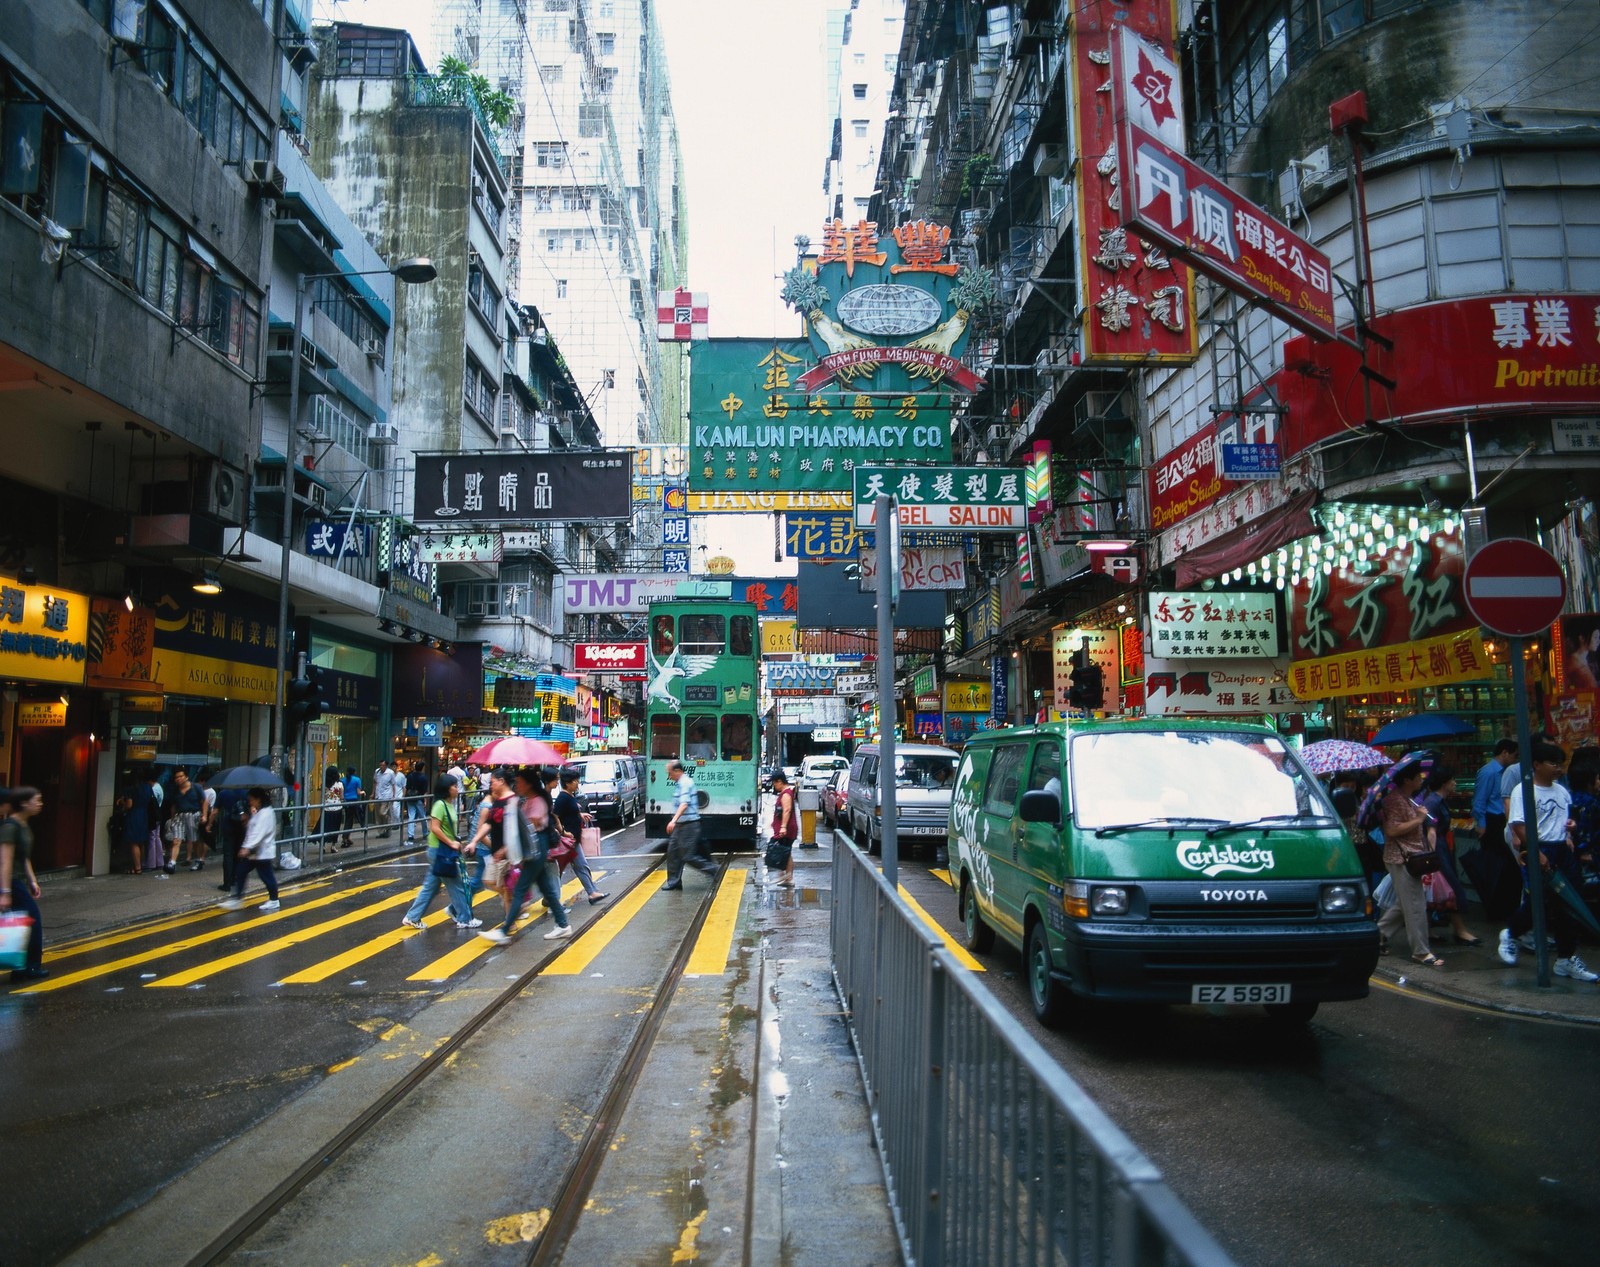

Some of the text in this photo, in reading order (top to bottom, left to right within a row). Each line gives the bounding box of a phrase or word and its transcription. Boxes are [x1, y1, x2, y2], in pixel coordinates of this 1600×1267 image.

[817, 217, 960, 278] 華豐
[1298, 291, 1333, 324] Studio
[1490, 300, 1600, 349] 專業
[825, 355, 850, 369] WAH
[853, 349, 880, 362] FUNG
[886, 349, 934, 365] MEDICINE
[1494, 359, 1600, 388] Portrait
[1557, 421, 1588, 431] Russell
[789, 426, 909, 448] PHARMACY
[913, 425, 944, 448] CO.
[1188, 478, 1222, 506] Studio
[869, 506, 1013, 526] GEL SALON
[566, 578, 637, 607] JMJ
[694, 583, 719, 595] 125
[638, 595, 655, 606] CUT
[769, 634, 791, 646] GRE
[188, 668, 209, 684] ASIA
[212, 672, 268, 690] COMMERCIAL
[769, 664, 840, 680] TANNOY
[950, 693, 988, 704] GREEN
[739, 816, 754, 826] 125
[1176, 839, 1275, 878] Carlsberg
[1200, 889, 1269, 901] TOYOTA
[1198, 985, 1287, 1003] EZ 5931
